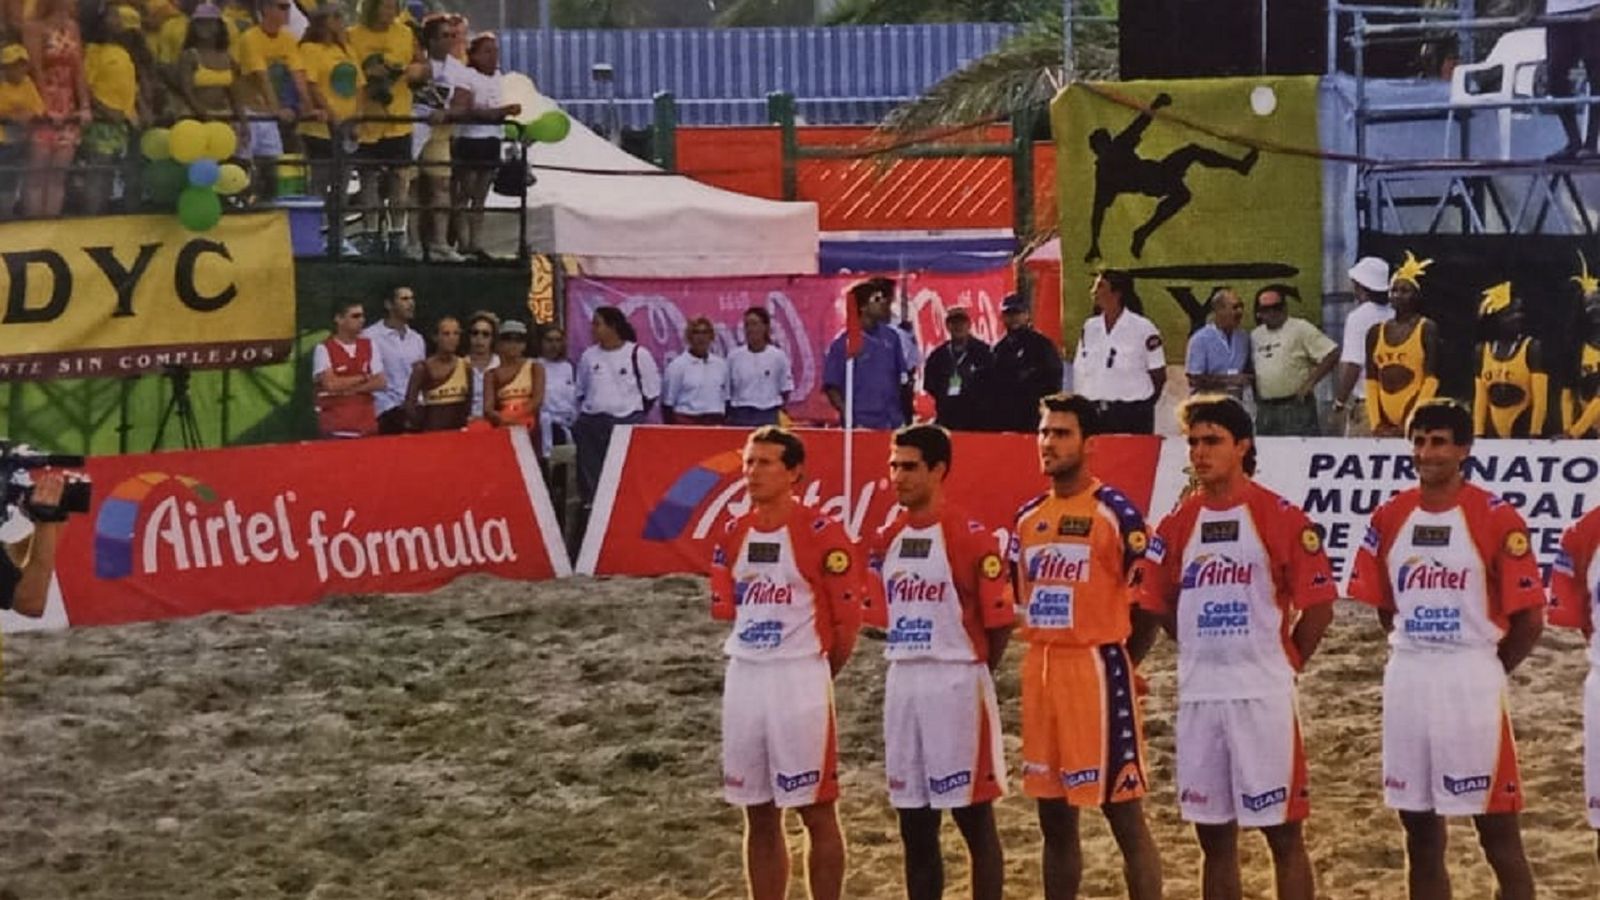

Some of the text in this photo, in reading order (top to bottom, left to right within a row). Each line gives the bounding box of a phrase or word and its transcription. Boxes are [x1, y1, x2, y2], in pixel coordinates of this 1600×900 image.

[2, 239, 238, 324] DYC
[58, 356, 103, 374] SIN
[119, 345, 275, 370] COMPLEJOS
[1308, 453, 1599, 483] PATRNATO
[143, 495, 518, 582] Airtel fórmula
[895, 579, 946, 602] Airtel
[1407, 564, 1468, 590] Airtel
[1204, 601, 1248, 615] Costa
[1414, 605, 1460, 619] Costa
